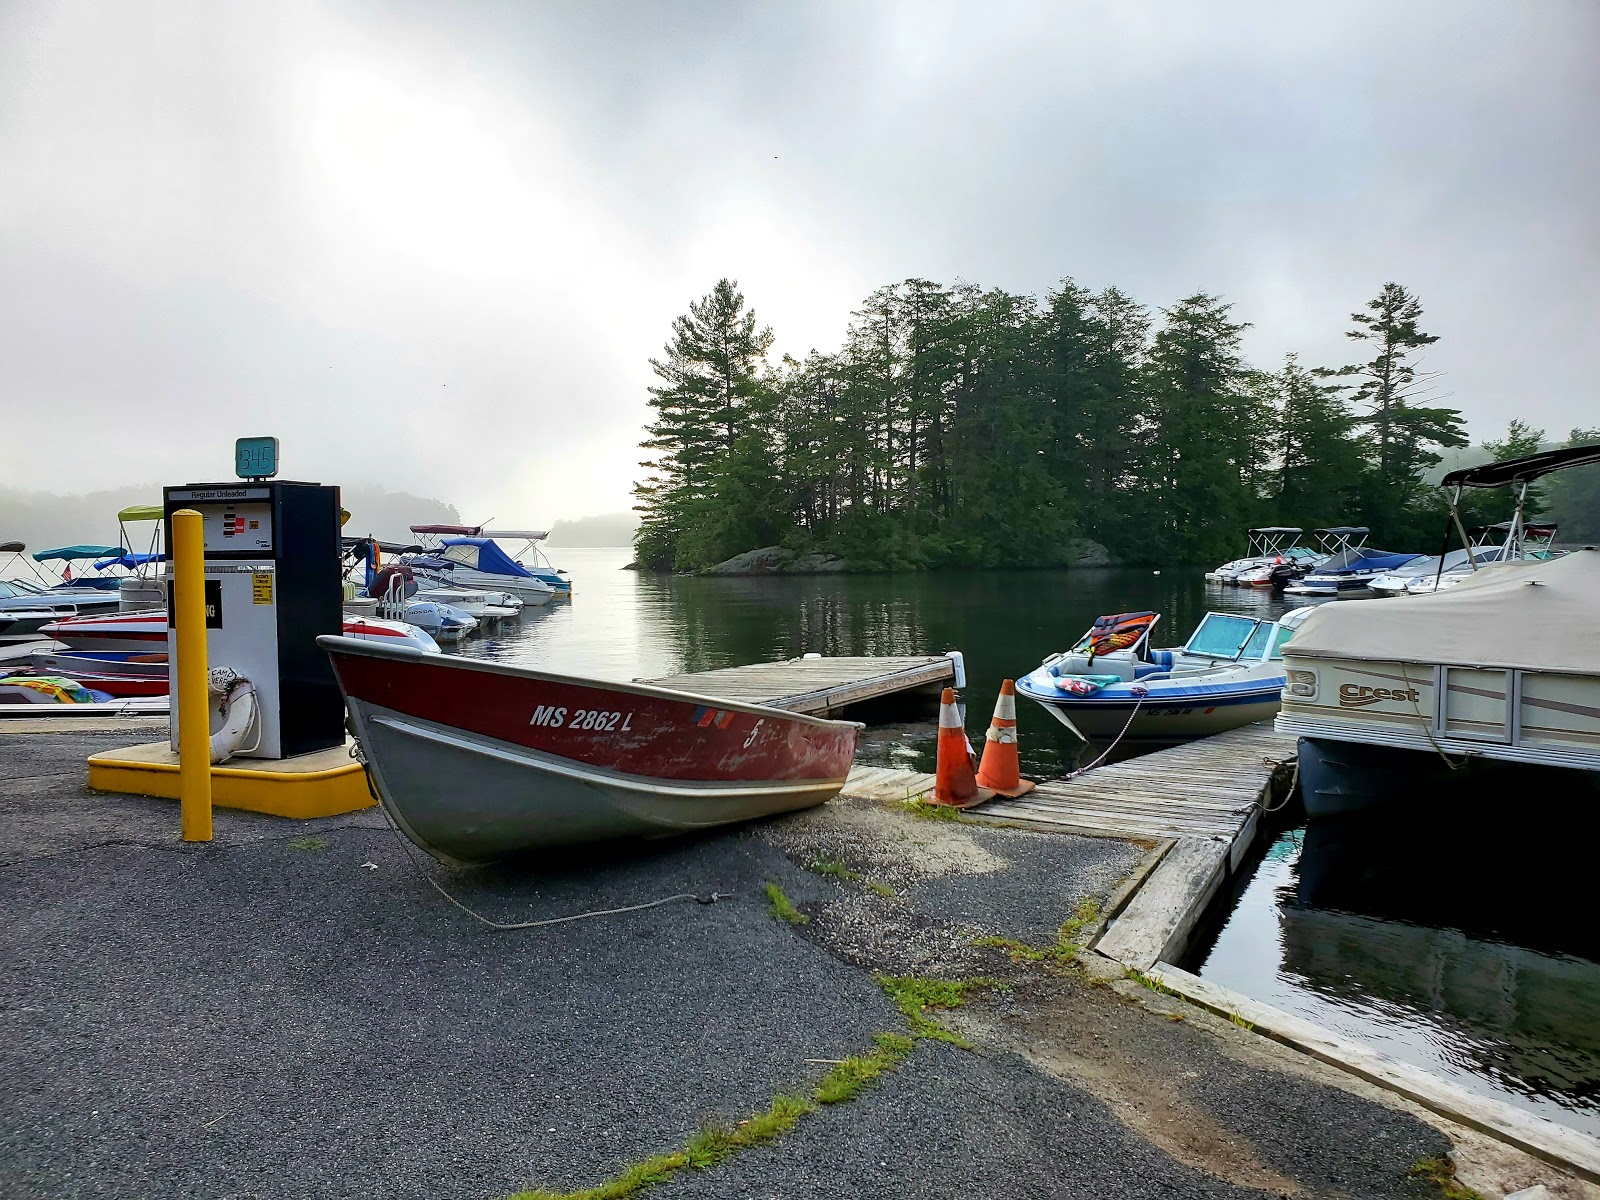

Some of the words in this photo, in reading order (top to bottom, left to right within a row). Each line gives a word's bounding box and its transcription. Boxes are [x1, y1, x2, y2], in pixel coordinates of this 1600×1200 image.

[191, 491, 216, 499] Regular
[217, 490, 247, 498] Unleaded
[212, 669, 233, 678] CAMP
[1340, 683, 1420, 703] Crest
[530, 705, 568, 728] MS
[568, 709, 621, 731] 2862
[621, 712, 633, 731] L
[743, 719, 764, 749] 5
